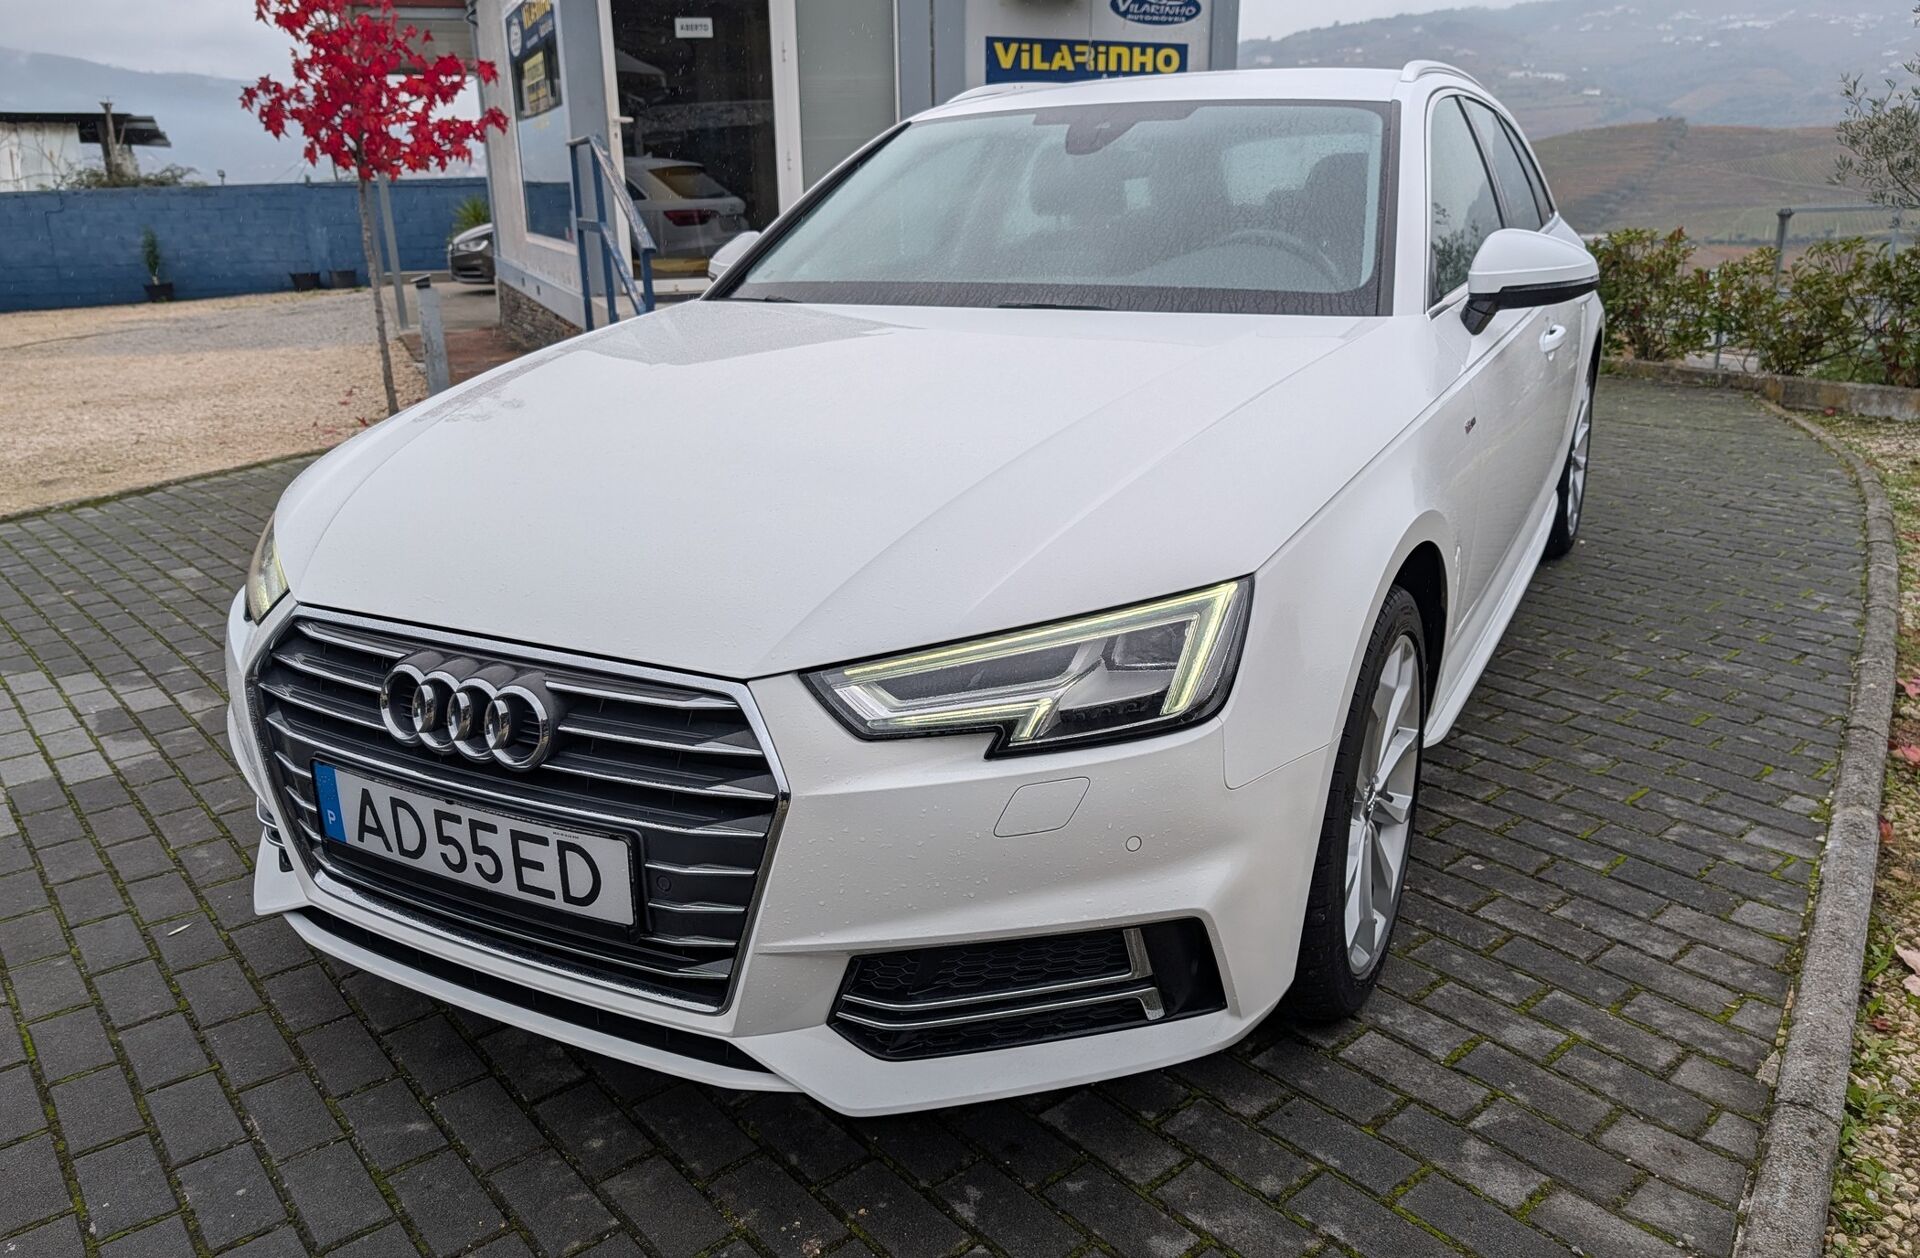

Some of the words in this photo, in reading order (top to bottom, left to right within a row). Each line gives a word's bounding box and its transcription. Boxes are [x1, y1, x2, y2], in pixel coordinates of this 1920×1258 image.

[1117, 0, 1197, 16] VILARINHO
[680, 23, 710, 32] ABERTO
[327, 809, 337, 825] P
